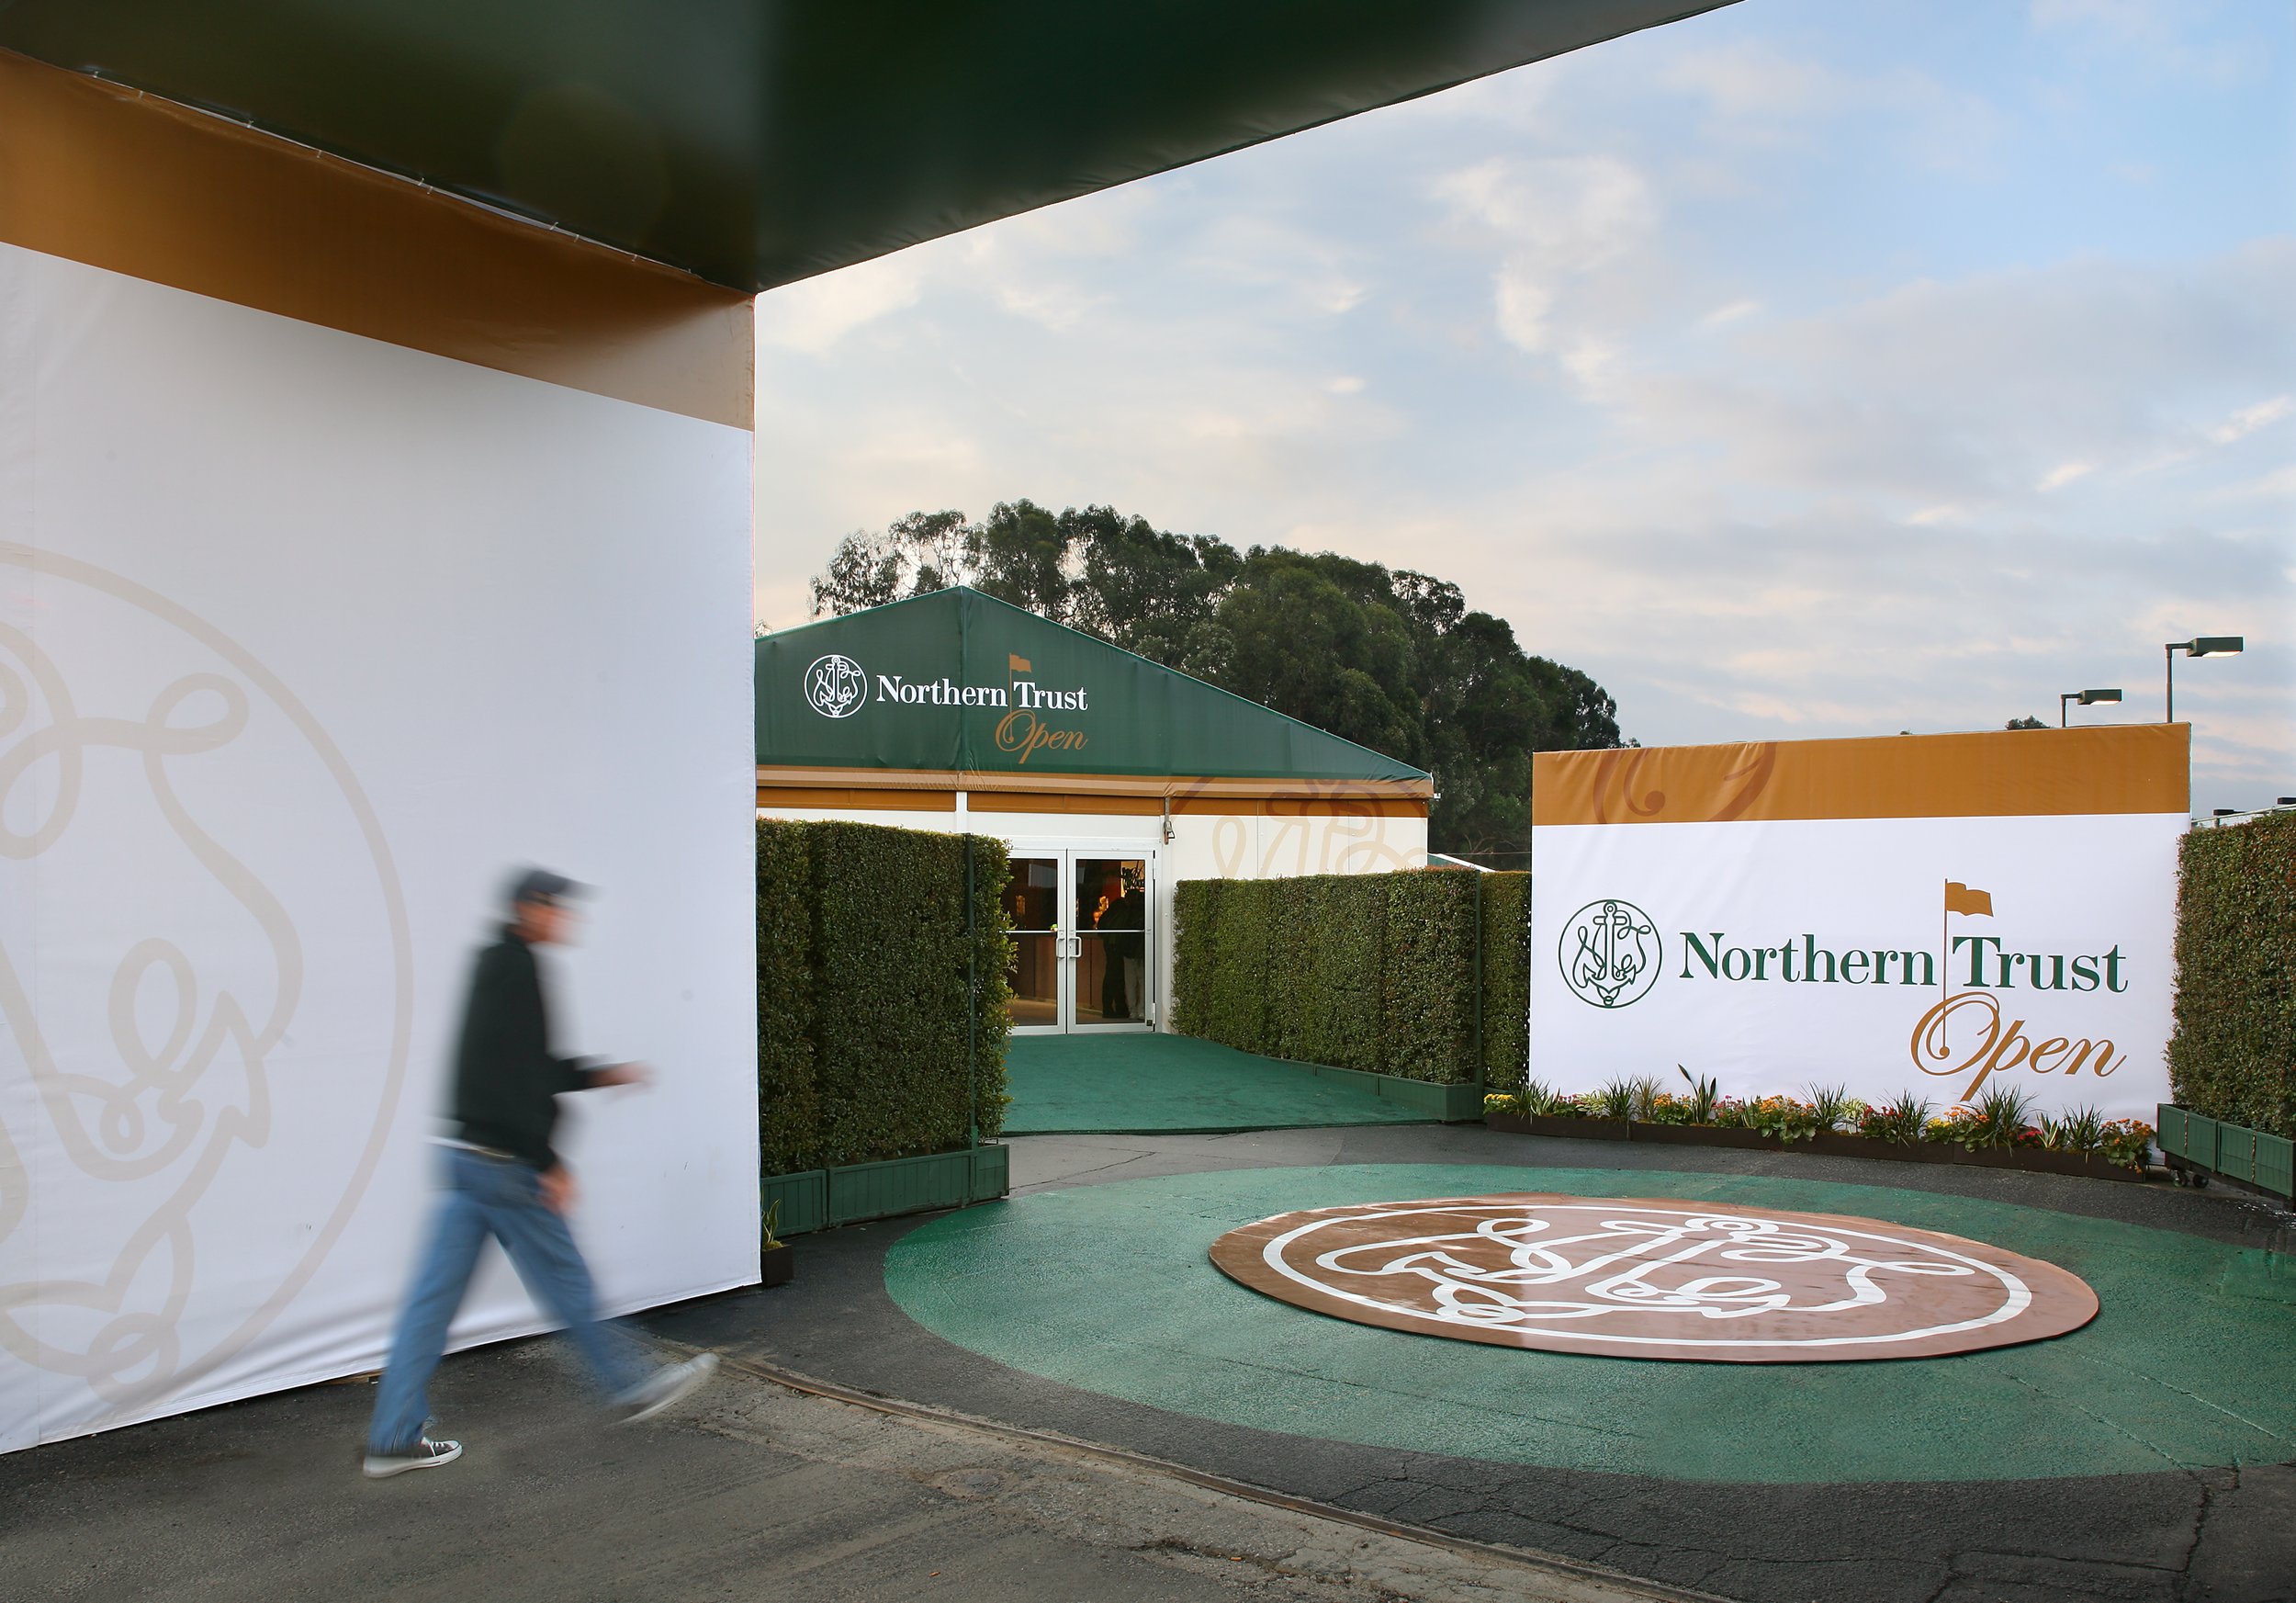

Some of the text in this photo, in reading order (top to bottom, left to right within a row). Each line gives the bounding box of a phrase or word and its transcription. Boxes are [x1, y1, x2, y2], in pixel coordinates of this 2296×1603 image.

[876, 674, 1088, 710] Northern Trust
[995, 710, 1088, 764] Open
[1679, 931, 2129, 993] Northern Trust
[1910, 991, 2127, 1101] Open
